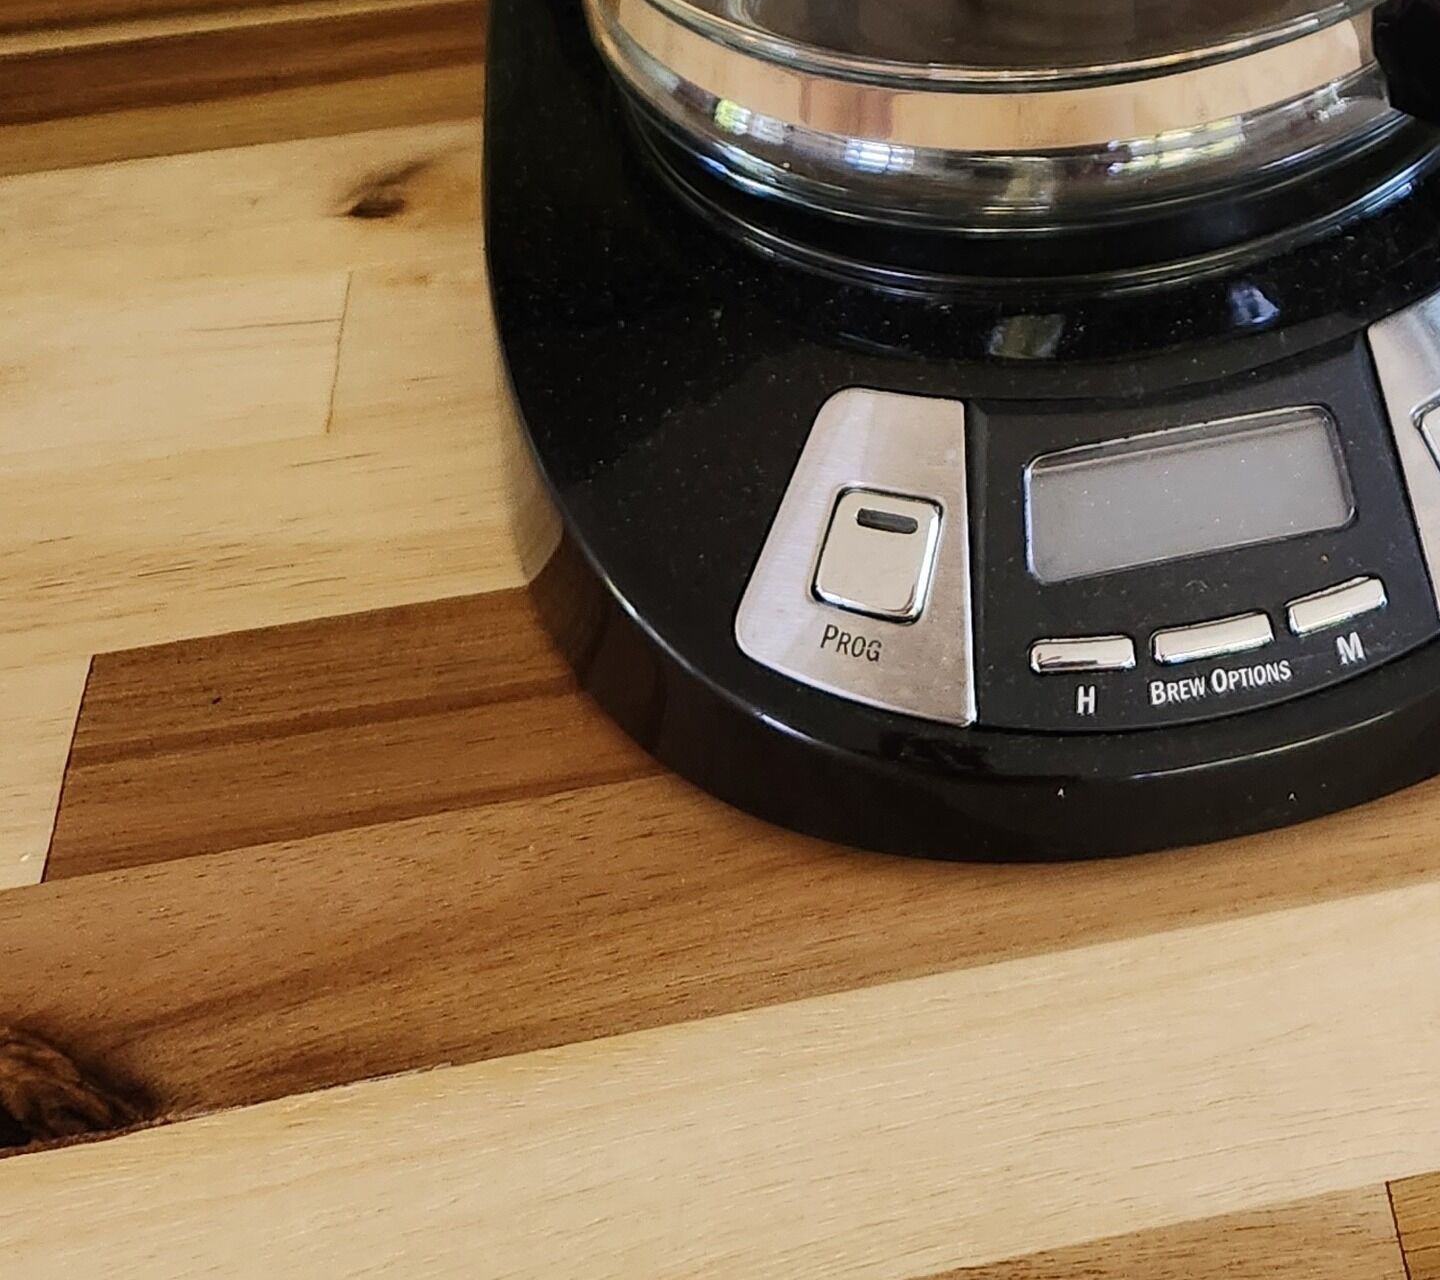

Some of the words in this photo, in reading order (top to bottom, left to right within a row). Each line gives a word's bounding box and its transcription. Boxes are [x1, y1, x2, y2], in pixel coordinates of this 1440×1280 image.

[820, 623, 882, 662] PROG
[1336, 632, 1368, 665] M
[1076, 684, 1097, 716] H
[1150, 675, 1207, 706] BREW
[1211, 659, 1293, 694] OPTIONS
